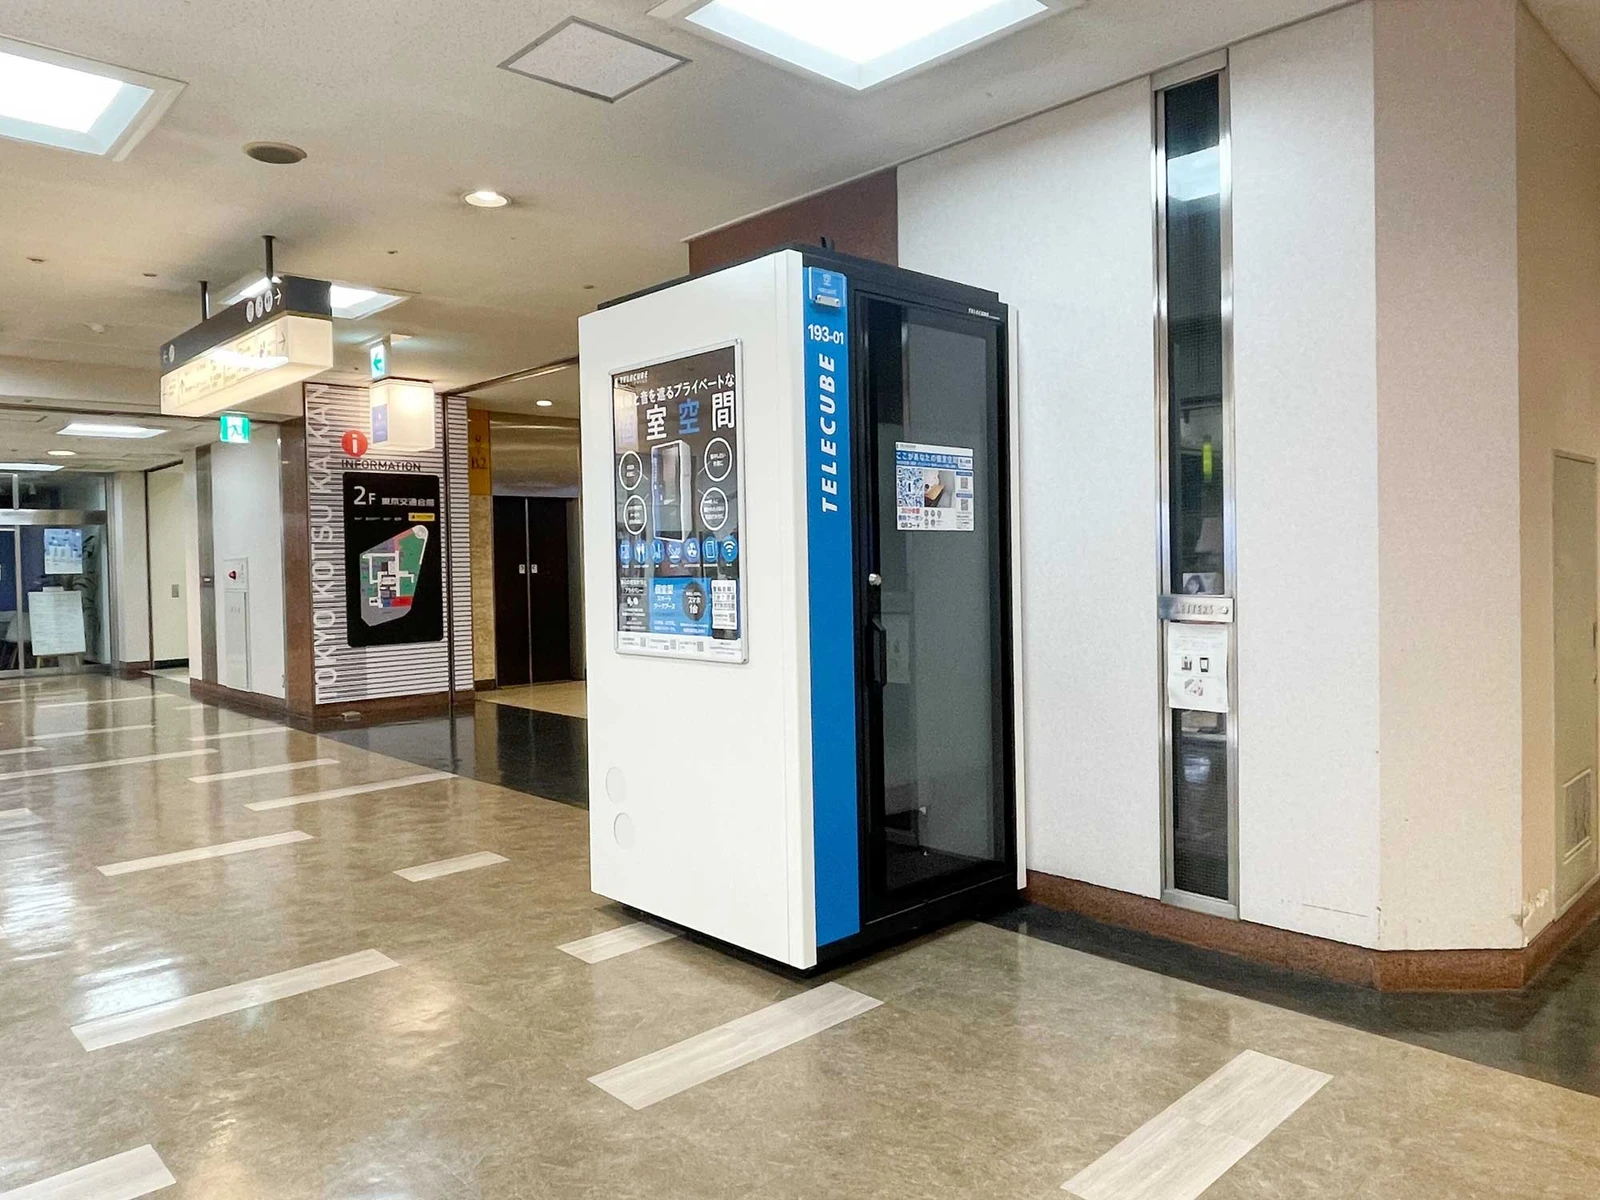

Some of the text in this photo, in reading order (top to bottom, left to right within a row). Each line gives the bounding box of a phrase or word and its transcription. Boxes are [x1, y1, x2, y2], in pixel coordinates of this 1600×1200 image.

[807, 323, 845, 345] 193-01
[615, 372, 735, 409] と音を遮るプライベートな
[818, 352, 838, 513] TELECUBE
[341, 459, 421, 472] INFORMATION
[353, 485, 376, 506] 2F
[306, 384, 337, 705] TOKYO KOTSU KAIKAN
